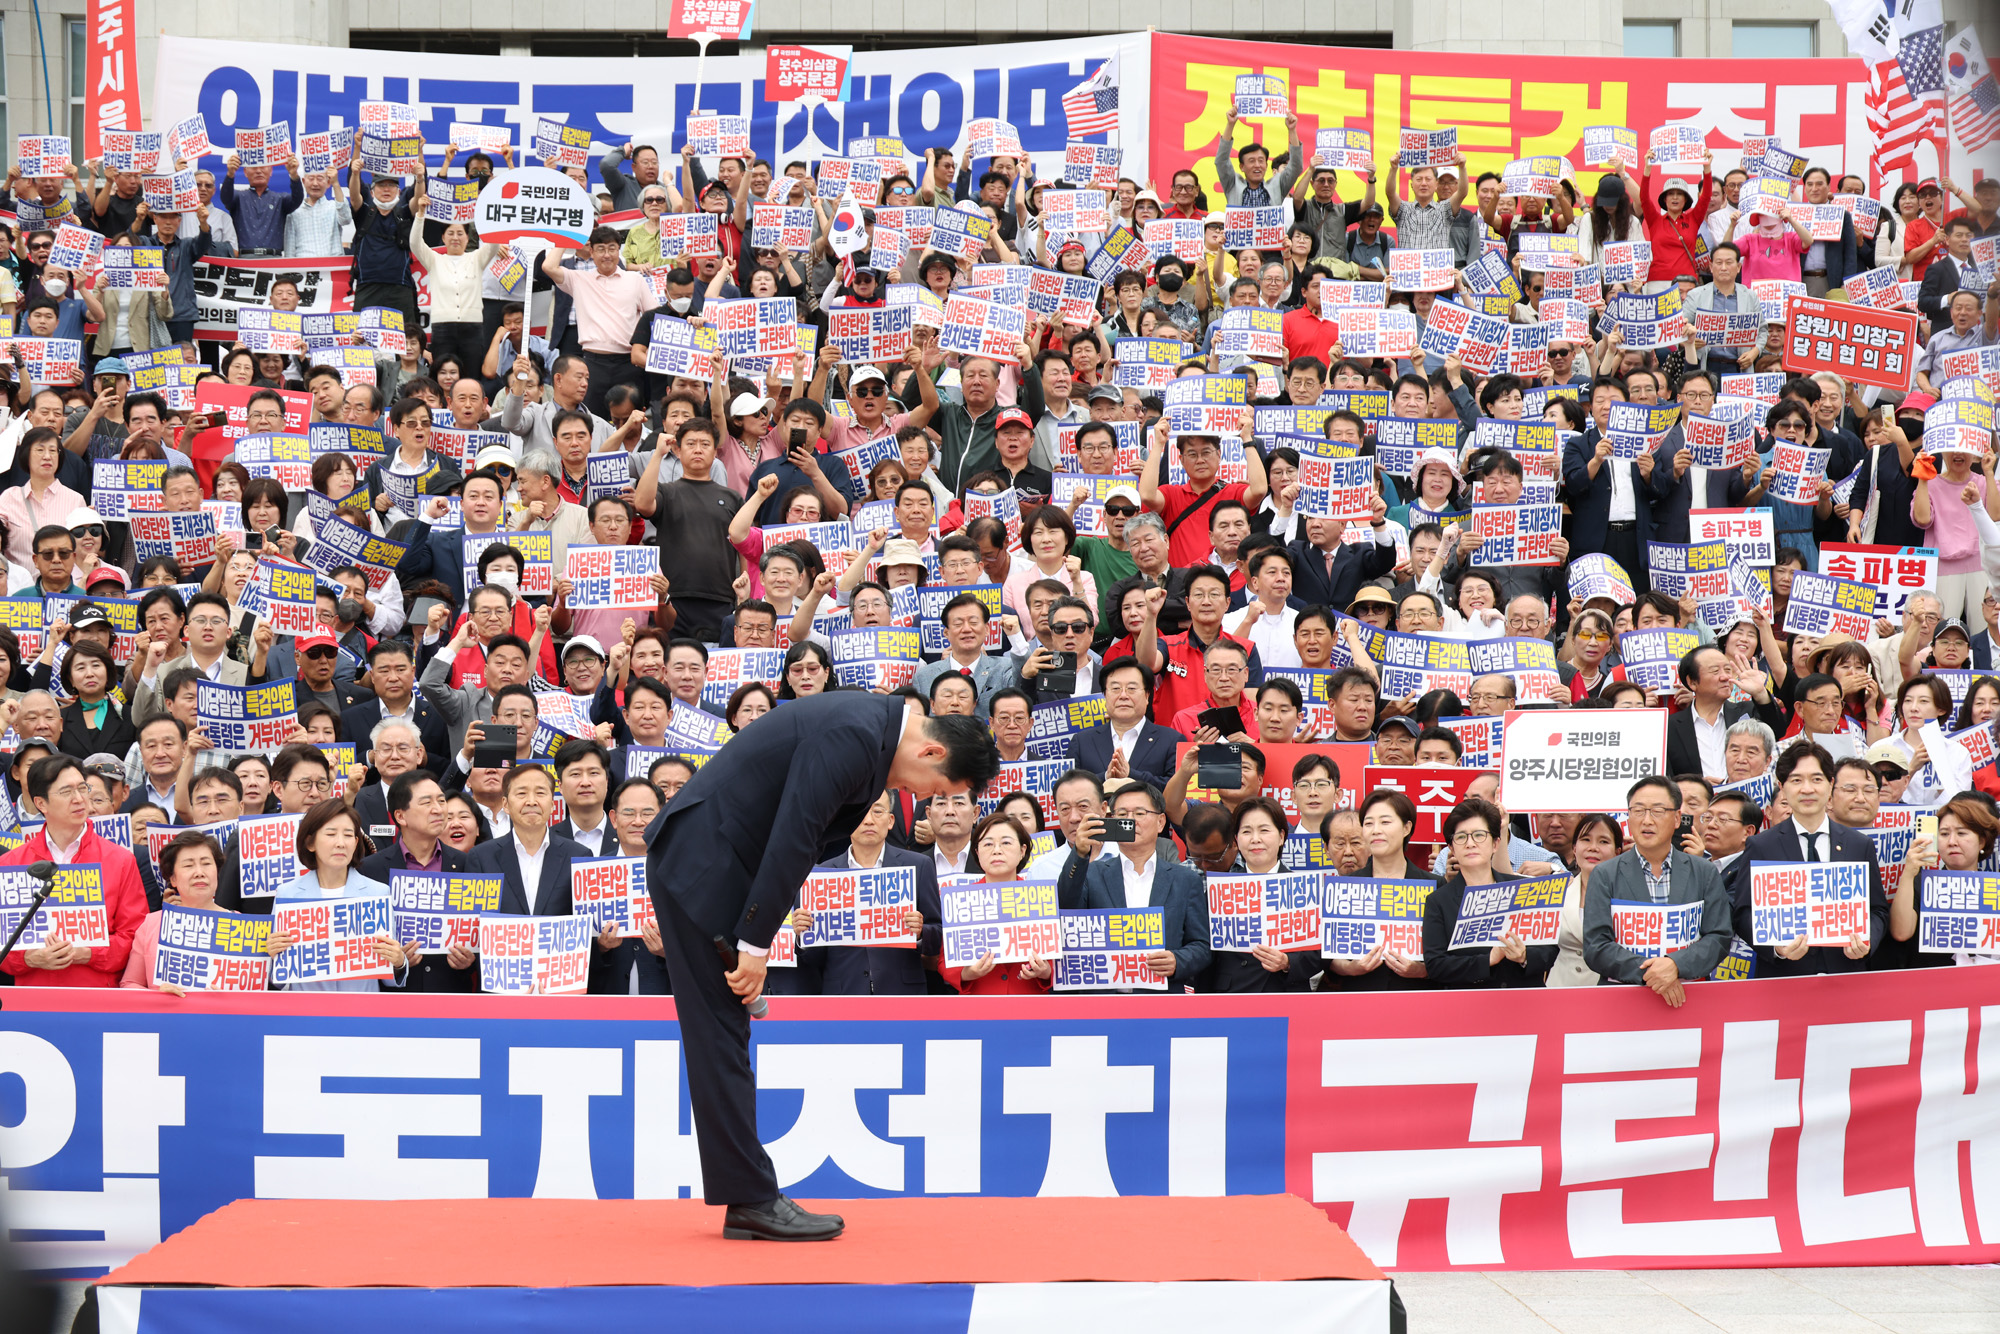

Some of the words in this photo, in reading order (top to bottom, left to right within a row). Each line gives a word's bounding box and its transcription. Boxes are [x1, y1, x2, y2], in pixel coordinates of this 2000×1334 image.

[681, 11, 740, 25] 상주문경
[682, 0, 742, 11] 보수의심장
[778, 72, 837, 87] 상주문경
[779, 59, 837, 71] 보수의심장
[236, 132, 263, 150] 야당탄압
[265, 125, 289, 147] 독재정치
[688, 119, 717, 137] 야당탄압
[719, 117, 748, 135] 독재정치
[1401, 131, 1428, 149] 야당탄압
[1430, 127, 1457, 147] 독재정치
[143, 179, 172, 196] 야당탄압
[174, 172, 197, 192] 독재정치
[521, 185, 570, 200] 국민의힘
[486, 203, 516, 223] 대구
[521, 205, 583, 228] 달서구병
[1044, 194, 1073, 214] 야당탄압
[1075, 191, 1106, 212] 독재정치
[662, 217, 685, 237] 야당탄압
[686, 215, 717, 234] 독재정치
[1225, 211, 1254, 230] 야당탄압
[1256, 208, 1285, 227] 독재정치
[1813, 221, 1842, 240] 규탄한다
[718, 303, 756, 331] 야당탄압
[758, 299, 796, 324] 독재정치
[947, 301, 985, 328] 야당탄압
[988, 309, 1025, 335] 독재정치
[1803, 301, 1825, 311] 국민의힘
[653, 320, 693, 346] 야당말살
[759, 324, 796, 350] 규탄한다
[830, 314, 870, 337] 야당탄압
[872, 309, 912, 332] 독재정치
[1340, 314, 1376, 334] 야당탄압
[1379, 310, 1416, 332] 독재정치
[1429, 302, 1467, 332] 야당탄압
[1467, 315, 1507, 345] 독재정치
[1696, 314, 1726, 332] 야당탄압
[1729, 313, 1759, 330] 독재정치
[1796, 314, 1848, 341] 창원시
[1852, 324, 1905, 351] 의창구
[942, 324, 983, 351] 정치보복
[648, 346, 688, 372] 대통령은
[311, 430, 349, 449] 야당말살
[350, 430, 384, 450] 특검악법
[1379, 424, 1416, 445] 야당말살
[1417, 424, 1456, 445] 특검악법
[132, 517, 171, 541] 야당탄압
[173, 516, 215, 538] 독재정치
[1473, 514, 1516, 539] 야당탄압
[1519, 508, 1561, 533] 독재정치
[1702, 520, 1762, 538] 송파구병
[175, 537, 216, 562] 규탄한다
[568, 552, 611, 579] 야당탄압
[614, 549, 658, 574] 독재정치
[1472, 538, 1514, 563] 정치보복
[1649, 546, 1687, 569] 야당말살
[1688, 542, 1726, 569] 특검악법
[272, 570, 314, 601] 특검악법
[1651, 572, 1686, 597] 대통령은
[1689, 570, 1729, 597] 거부하라
[1827, 554, 1926, 587] 송파병
[614, 576, 657, 603] 규탄한다
[1792, 575, 1836, 603] 야당말살
[1838, 582, 1876, 613] 특검악법
[270, 603, 314, 632] 거부하라
[1787, 603, 1829, 633] 대통령은
[832, 634, 875, 661] 야당말살
[877, 634, 919, 659] 특검악법
[1386, 637, 1427, 666] 야당말살
[1471, 644, 1514, 674] 야당말살
[1516, 640, 1557, 670] 특검악법
[835, 663, 876, 688] 대통령은
[879, 661, 917, 687] 거부하라
[1384, 669, 1424, 696] 대통령은
[199, 685, 243, 718] 야당말살
[245, 681, 294, 716] 특검악법
[1567, 731, 1620, 746] 국민의힘
[1509, 757, 1657, 781] 양주시당원협의회
[241, 821, 294, 859] 야당탄압
[50, 870, 100, 901] 특검악법
[242, 858, 295, 895] 정치보복
[573, 865, 628, 901] 야당탄압
[802, 876, 854, 909] 야당탄압
[860, 868, 914, 906] 독재정치
[1753, 870, 1807, 906] 야당탄압
[1811, 867, 1866, 900] 독재정치
[392, 876, 447, 911] 야당말살
[449, 879, 501, 911] 특검악법
[944, 889, 999, 924] 야당말살
[1001, 884, 1057, 919] 특검악법
[1209, 880, 1262, 914] 야당탄압
[1265, 874, 1322, 912] 독재정치
[1325, 881, 1378, 916] 야당말살
[1380, 883, 1436, 916] 특검악법
[1461, 886, 1516, 919] 야당말살
[1514, 876, 1569, 910] 특검악법
[1923, 876, 1981, 910] 야당말살
[52, 910, 106, 941] 거부하라
[163, 911, 213, 950] 야당말살
[215, 917, 272, 953] 특검악법
[277, 906, 329, 944] 야당탄압
[333, 896, 389, 937] 독재정치
[392, 917, 443, 947] 대통령은
[803, 909, 855, 943] 정치보복
[860, 907, 913, 939] 규탄한다
[1108, 913, 1163, 946] 특검악법
[1210, 916, 1262, 950] 정치보복
[1266, 908, 1321, 946] 규탄한다
[1452, 917, 1503, 947] 대통령은
[1508, 911, 1560, 941] 거부하라
[1613, 910, 1663, 945] 야당탄압
[1755, 905, 1808, 943] 정치보복
[1812, 904, 1868, 937] 규탄한다
[1922, 916, 1978, 950] 대통령은
[481, 924, 535, 956] 야당탄압
[538, 919, 590, 953] 독재정치
[946, 927, 1000, 961] 대통령은
[1003, 923, 1060, 957] 거부하라
[1325, 921, 1375, 956] 대통령은
[157, 950, 208, 988] 대통령은
[212, 958, 267, 990] 거부하라
[276, 941, 330, 981] 정치보복
[482, 958, 533, 991] 정치보복
[537, 951, 588, 991] 규탄한다
[1054, 953, 1108, 986] 대통령은
[1111, 952, 1165, 984] 거부하라
